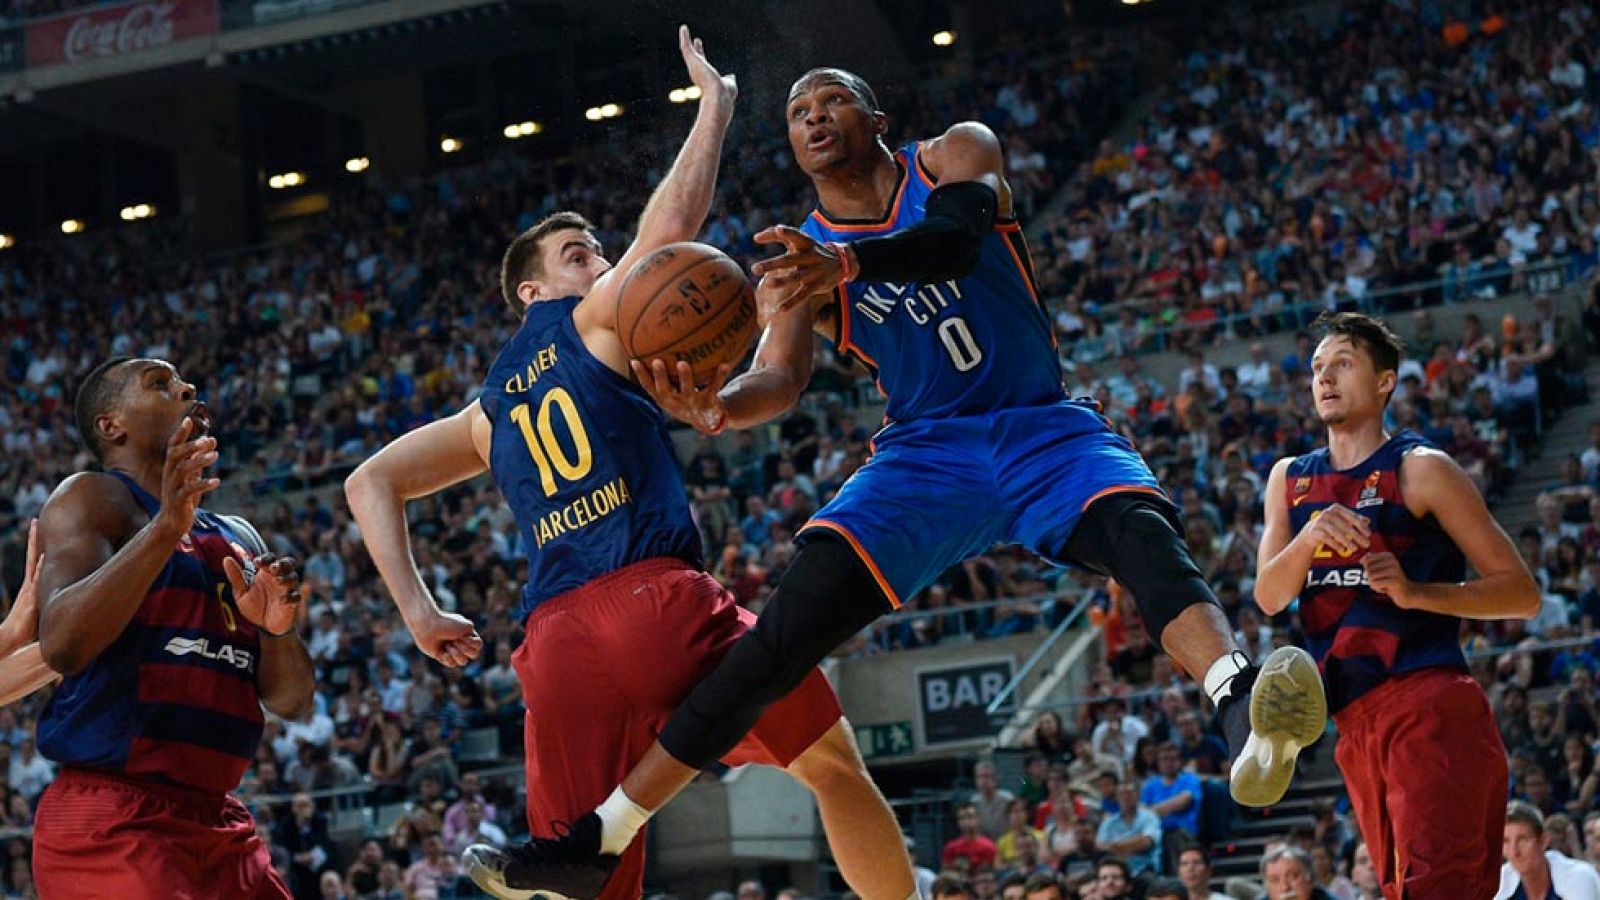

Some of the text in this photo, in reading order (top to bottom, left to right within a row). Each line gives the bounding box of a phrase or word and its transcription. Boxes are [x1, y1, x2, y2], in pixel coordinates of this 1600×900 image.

[903, 278, 962, 325] CITY
[937, 316, 983, 372] 0
[509, 386, 593, 498] 10
[200, 637, 254, 674] LAS
[926, 671, 1005, 712] BAR
